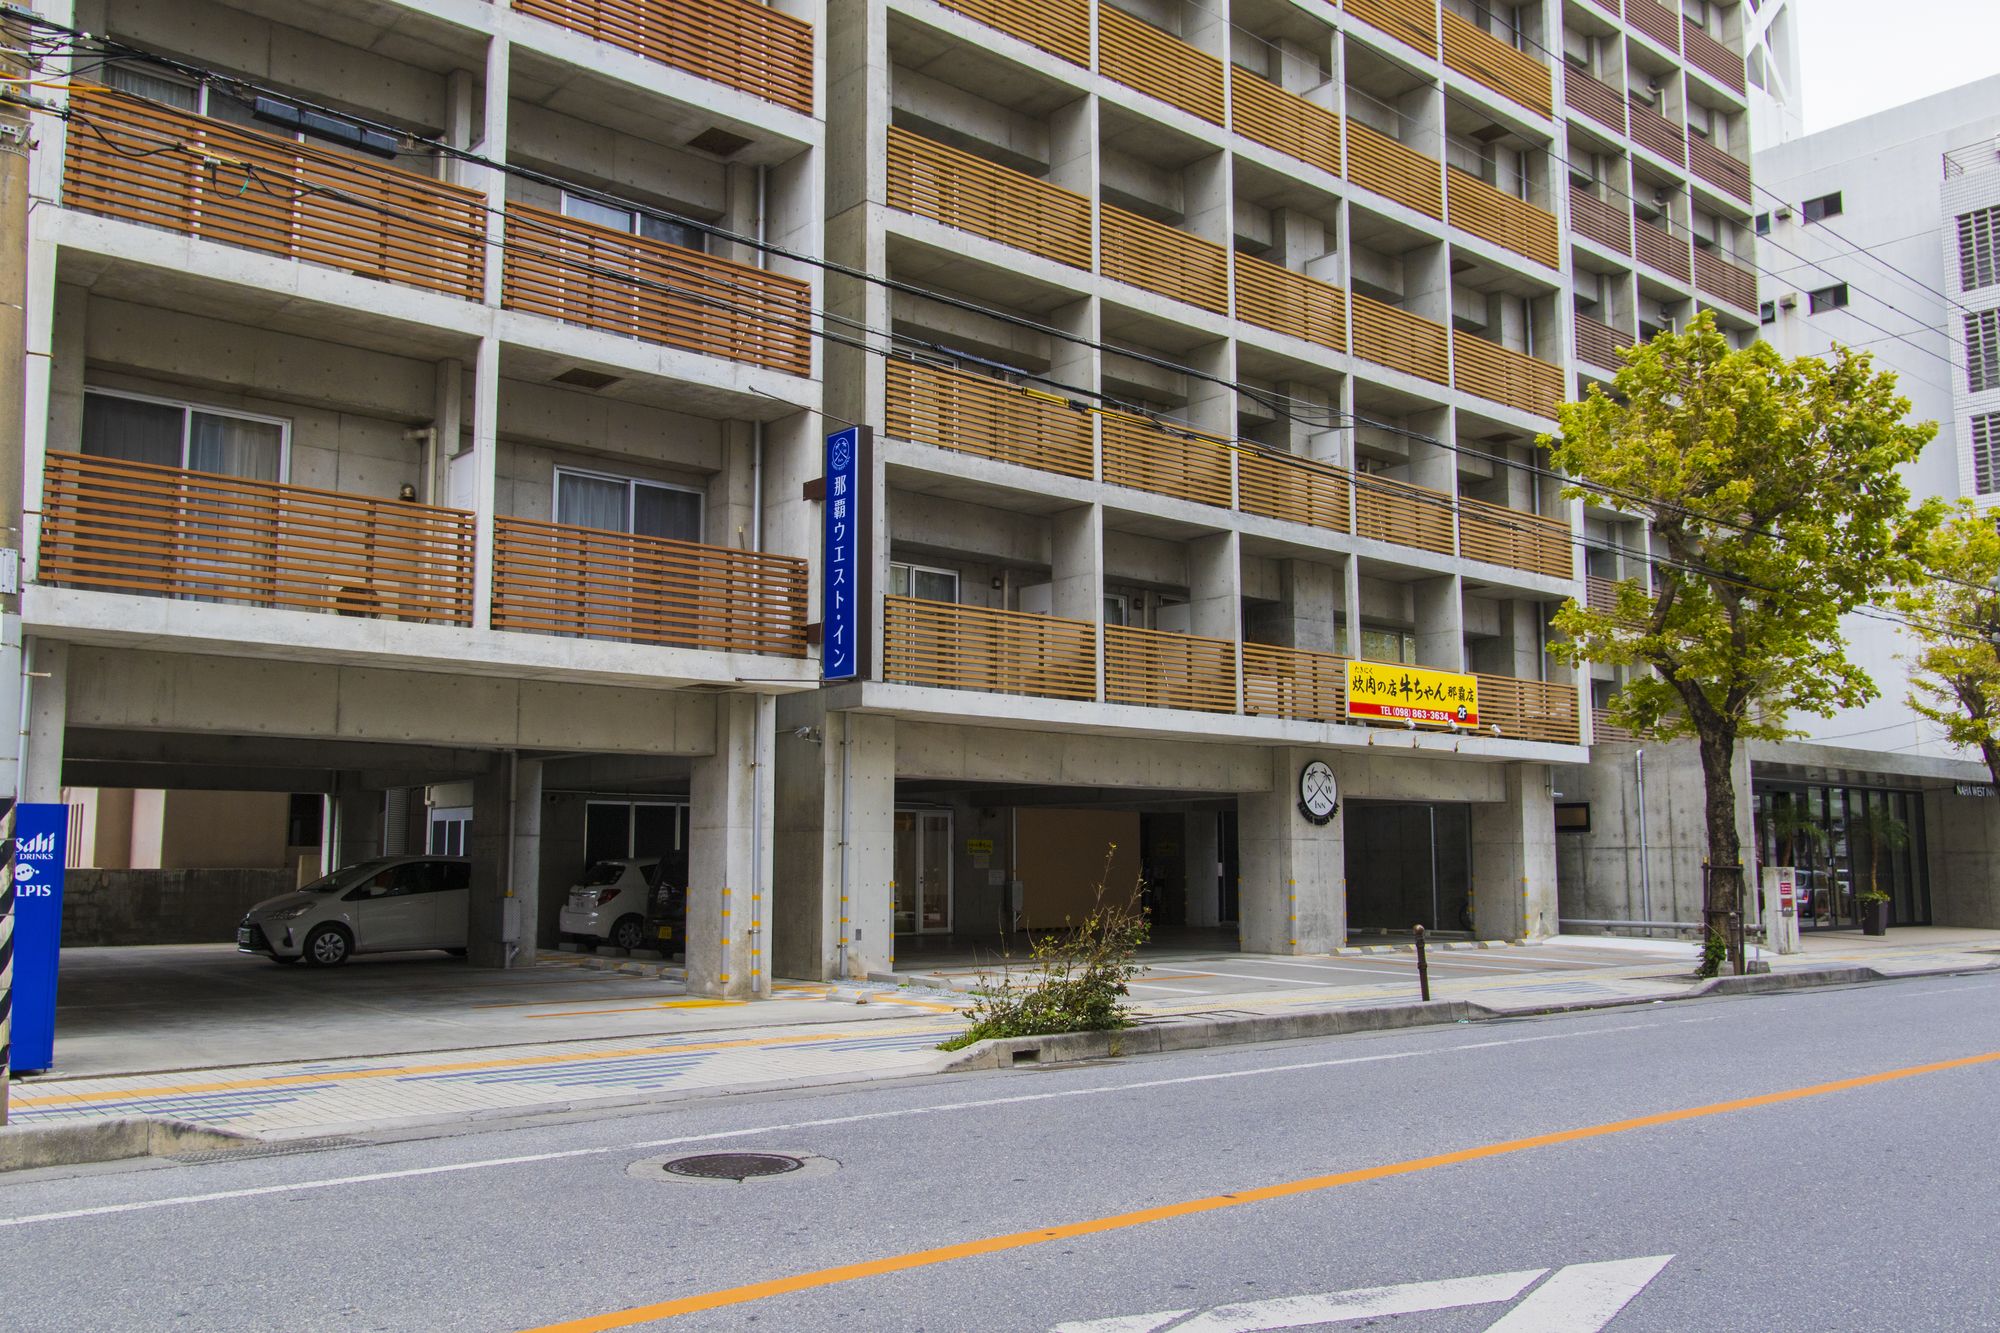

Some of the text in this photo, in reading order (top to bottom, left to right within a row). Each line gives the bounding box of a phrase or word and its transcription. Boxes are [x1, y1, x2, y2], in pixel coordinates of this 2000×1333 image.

[833, 474, 847, 668] 那覇ウエスト・イン
[1380, 706, 1392, 716] TEL
[1458, 706, 1467, 719] 2F
[15, 832, 55, 853] sahi
[15, 884, 52, 897] LPIS
